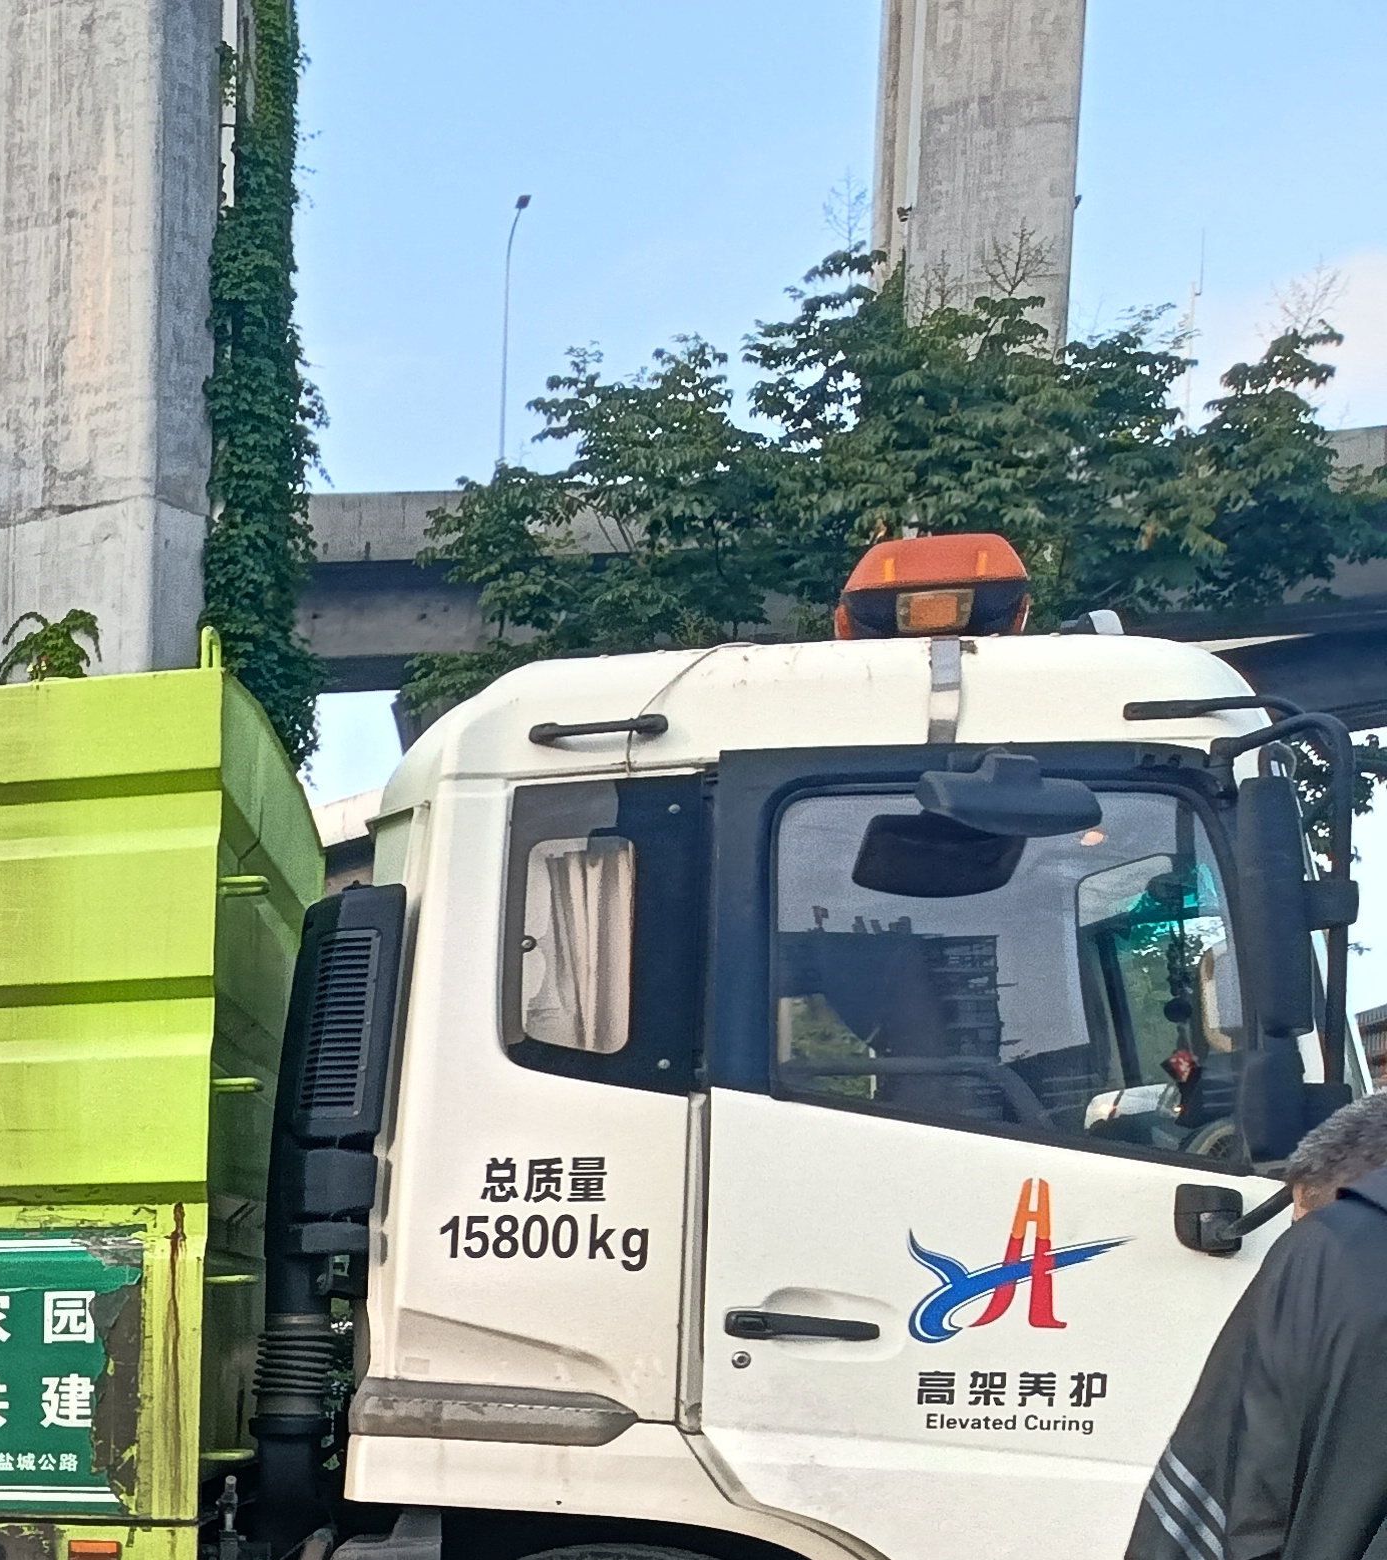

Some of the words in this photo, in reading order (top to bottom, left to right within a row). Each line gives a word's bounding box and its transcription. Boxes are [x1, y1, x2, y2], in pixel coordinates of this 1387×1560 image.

[481, 1156, 608, 1203] 总质量
[917, 1371, 1108, 1407] 高架养护
[925, 1413, 1018, 1432] Elevated
[1024, 1414, 1094, 1434] Curing
